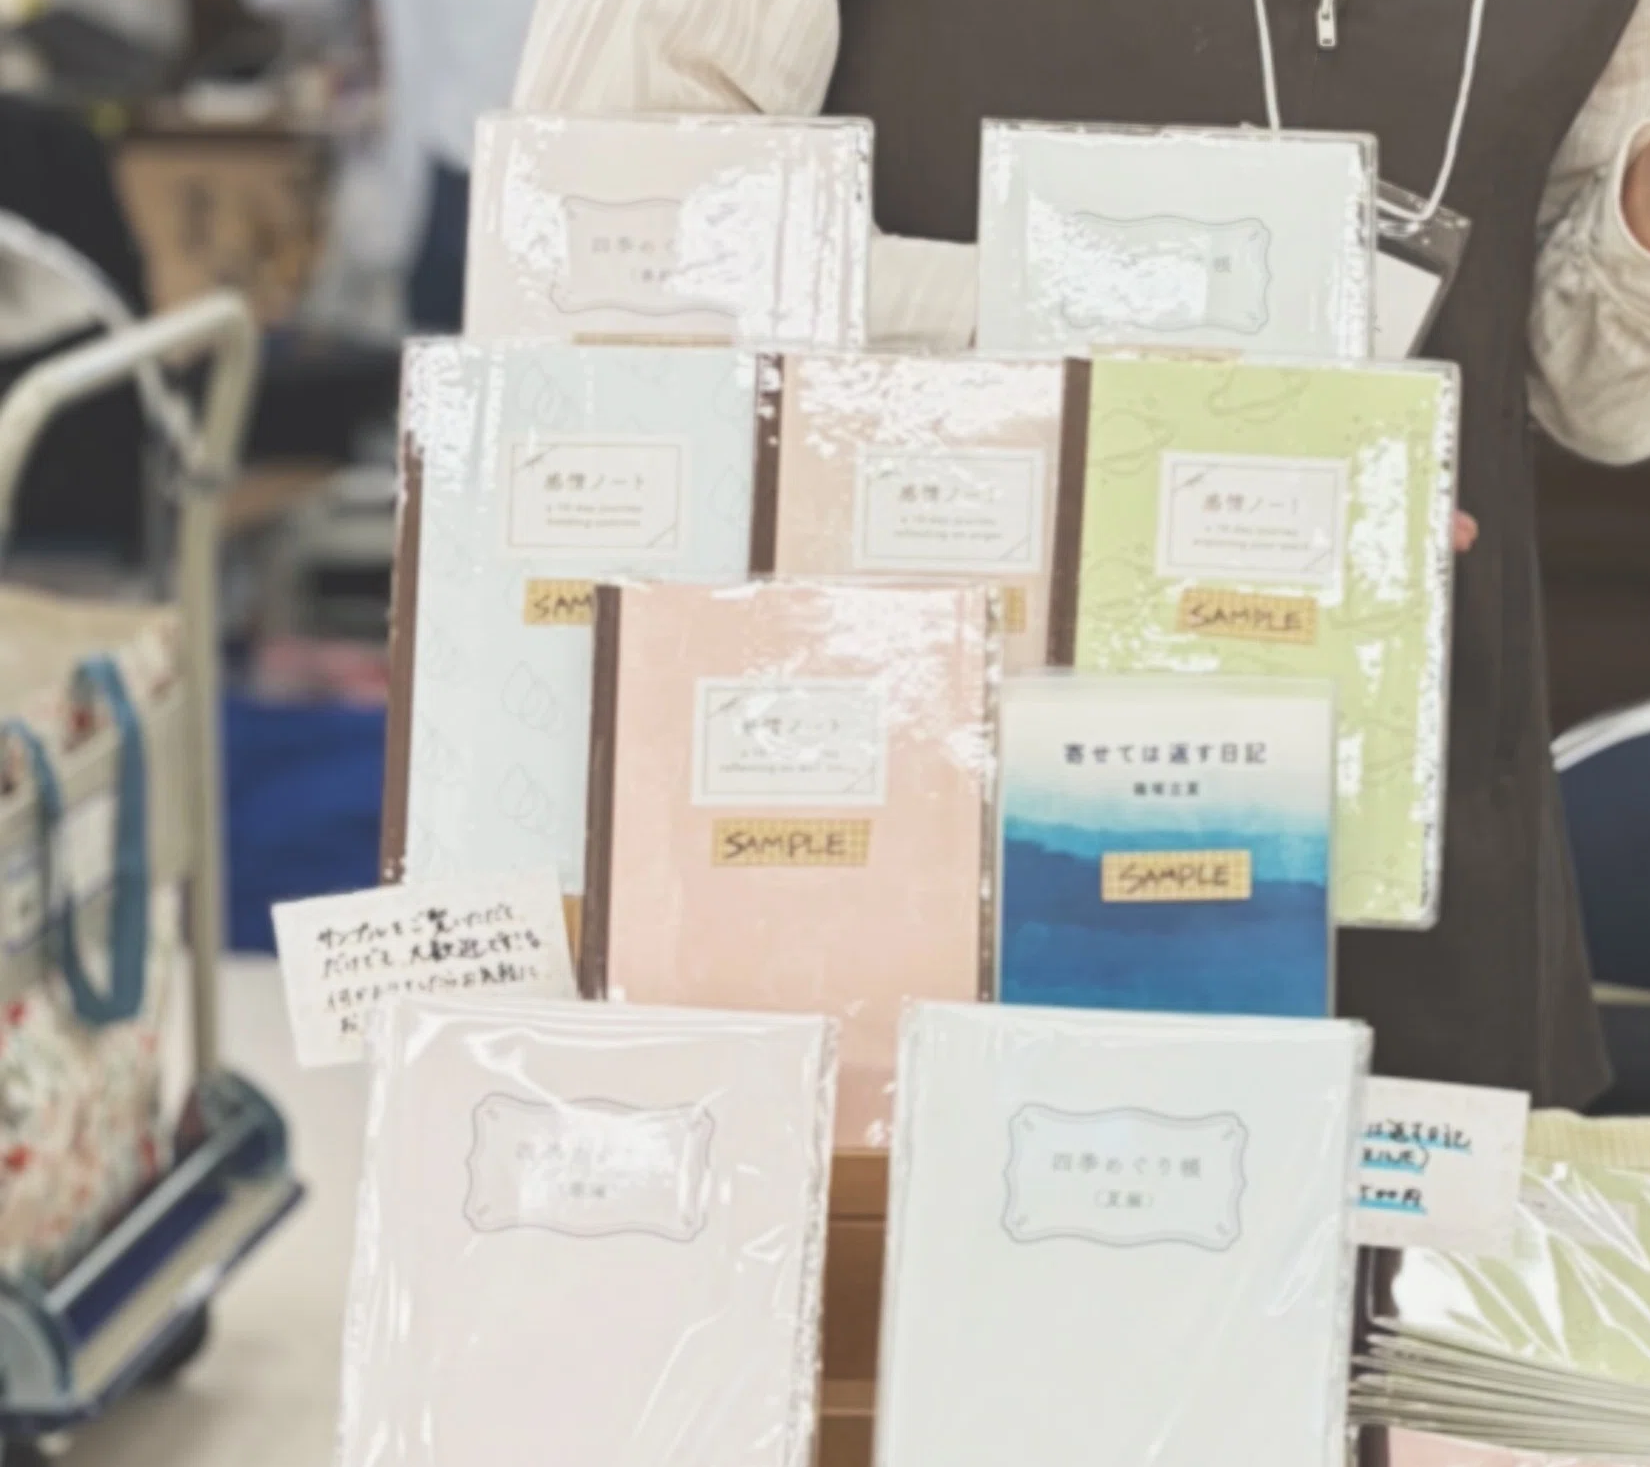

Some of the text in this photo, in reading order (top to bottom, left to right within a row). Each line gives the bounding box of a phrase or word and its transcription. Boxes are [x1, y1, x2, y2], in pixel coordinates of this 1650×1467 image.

[1188, 603, 1302, 632] SAMPLE
[1064, 742, 1267, 765] 寄せては返す日記
[724, 830, 846, 860] SAMPLE
[1119, 862, 1230, 894] SAMPLE
